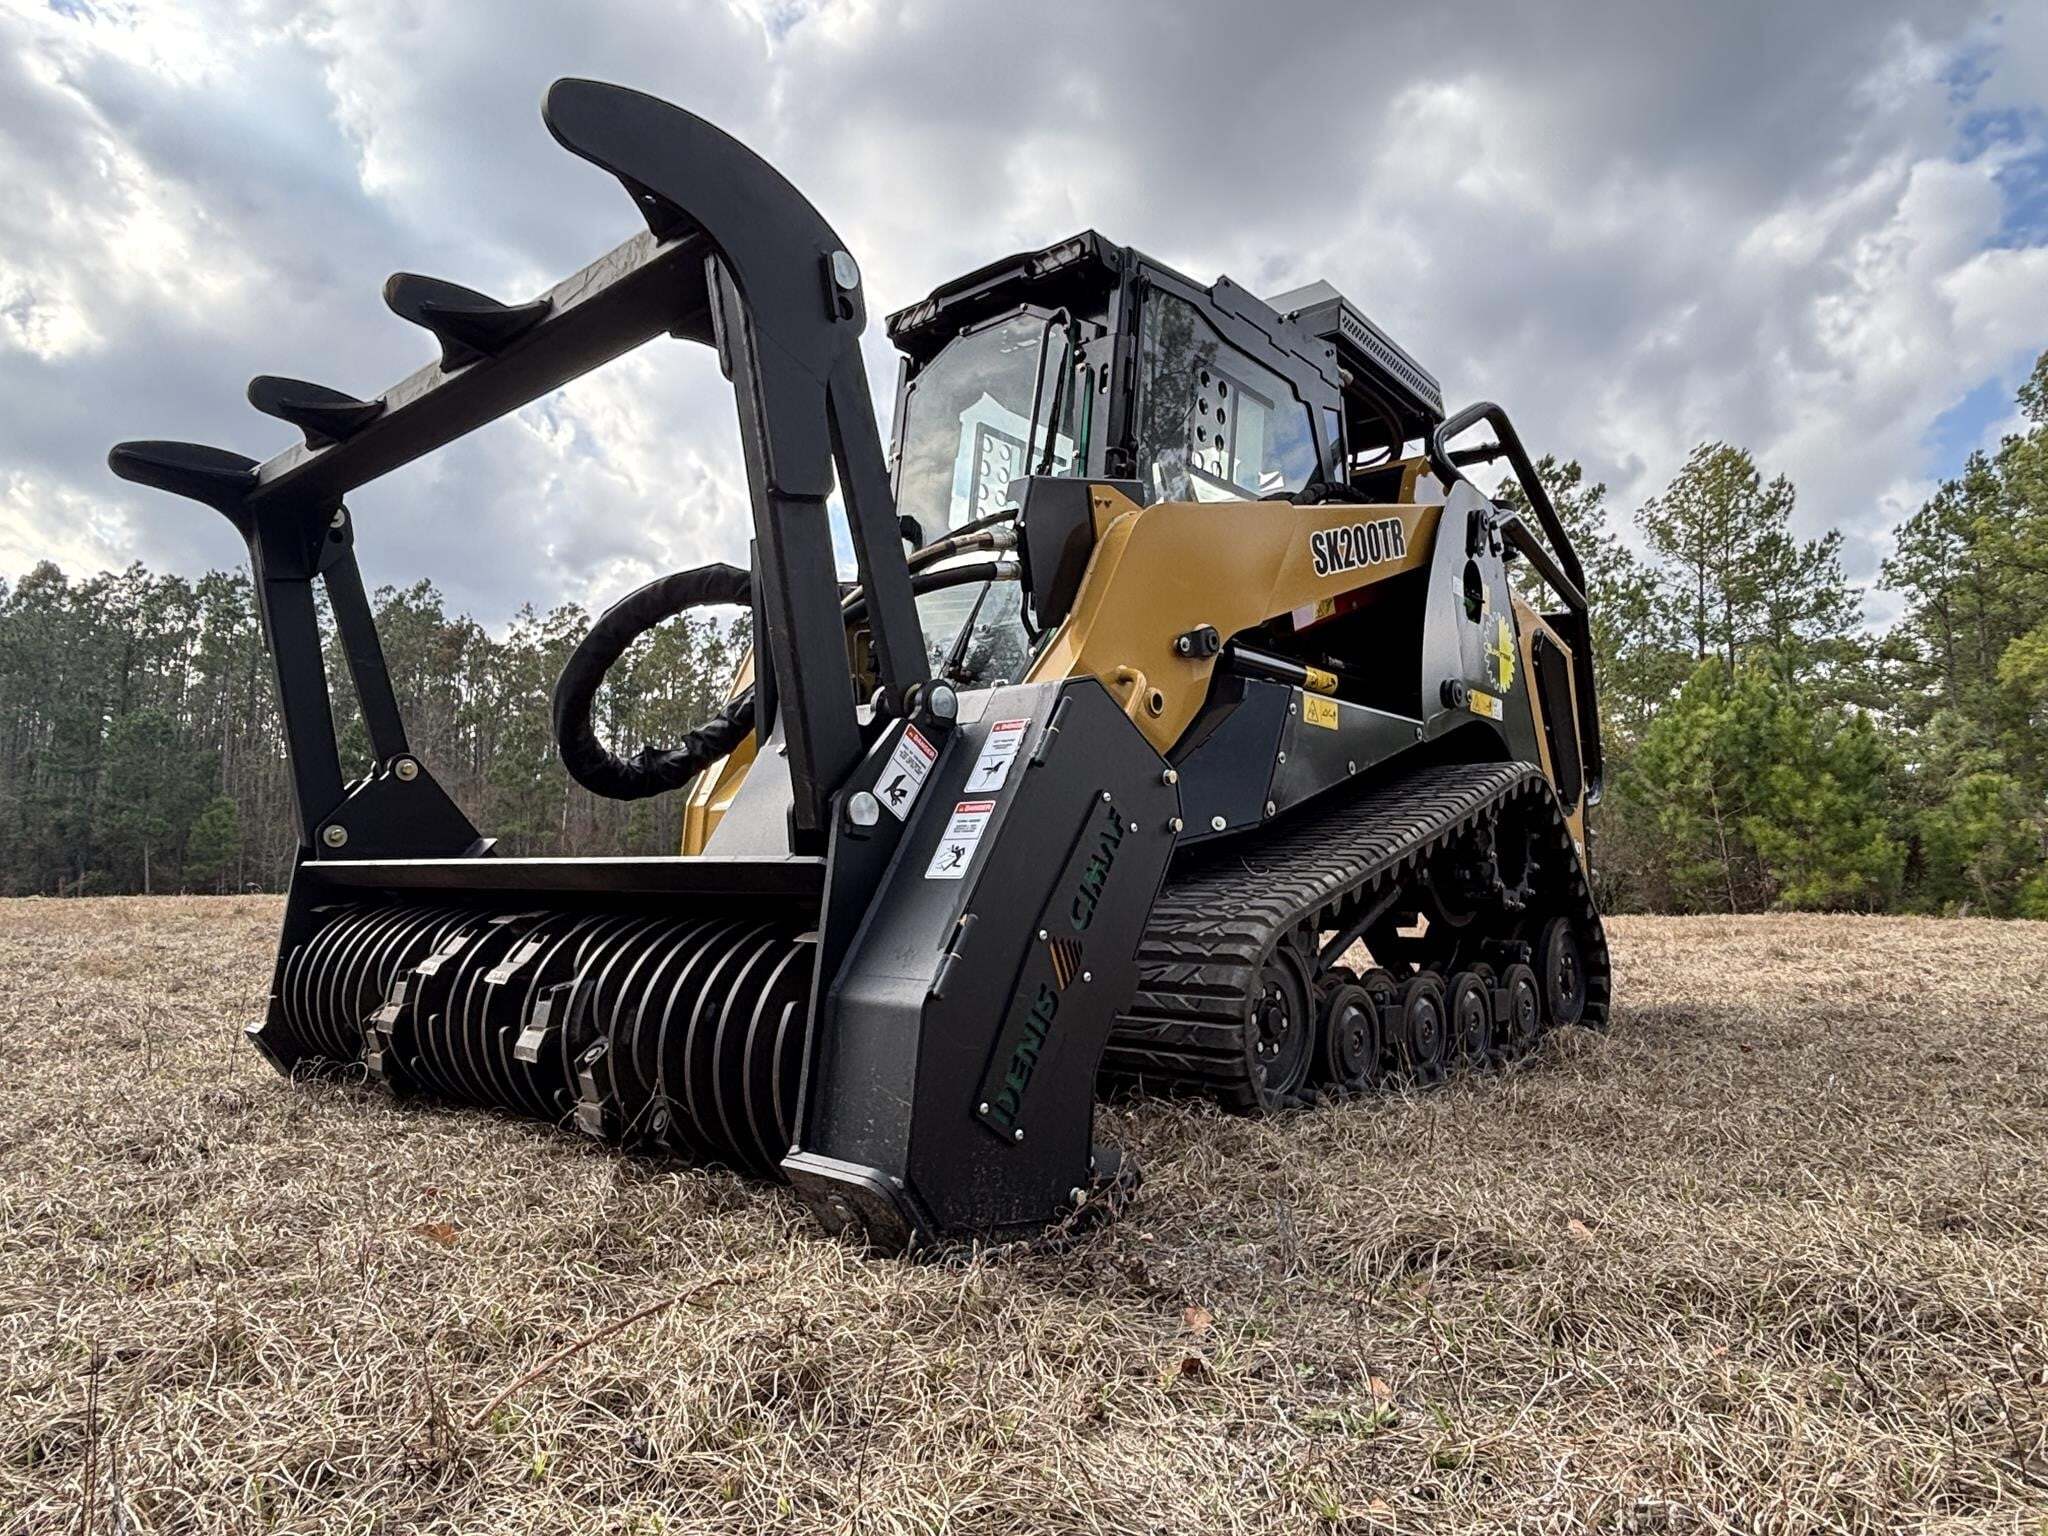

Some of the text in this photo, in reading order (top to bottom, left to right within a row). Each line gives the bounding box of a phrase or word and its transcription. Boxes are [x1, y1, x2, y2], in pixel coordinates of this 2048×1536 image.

[1311, 519, 1407, 576] SK200TR
[994, 806, 1124, 1126] DENIS CIMAF
